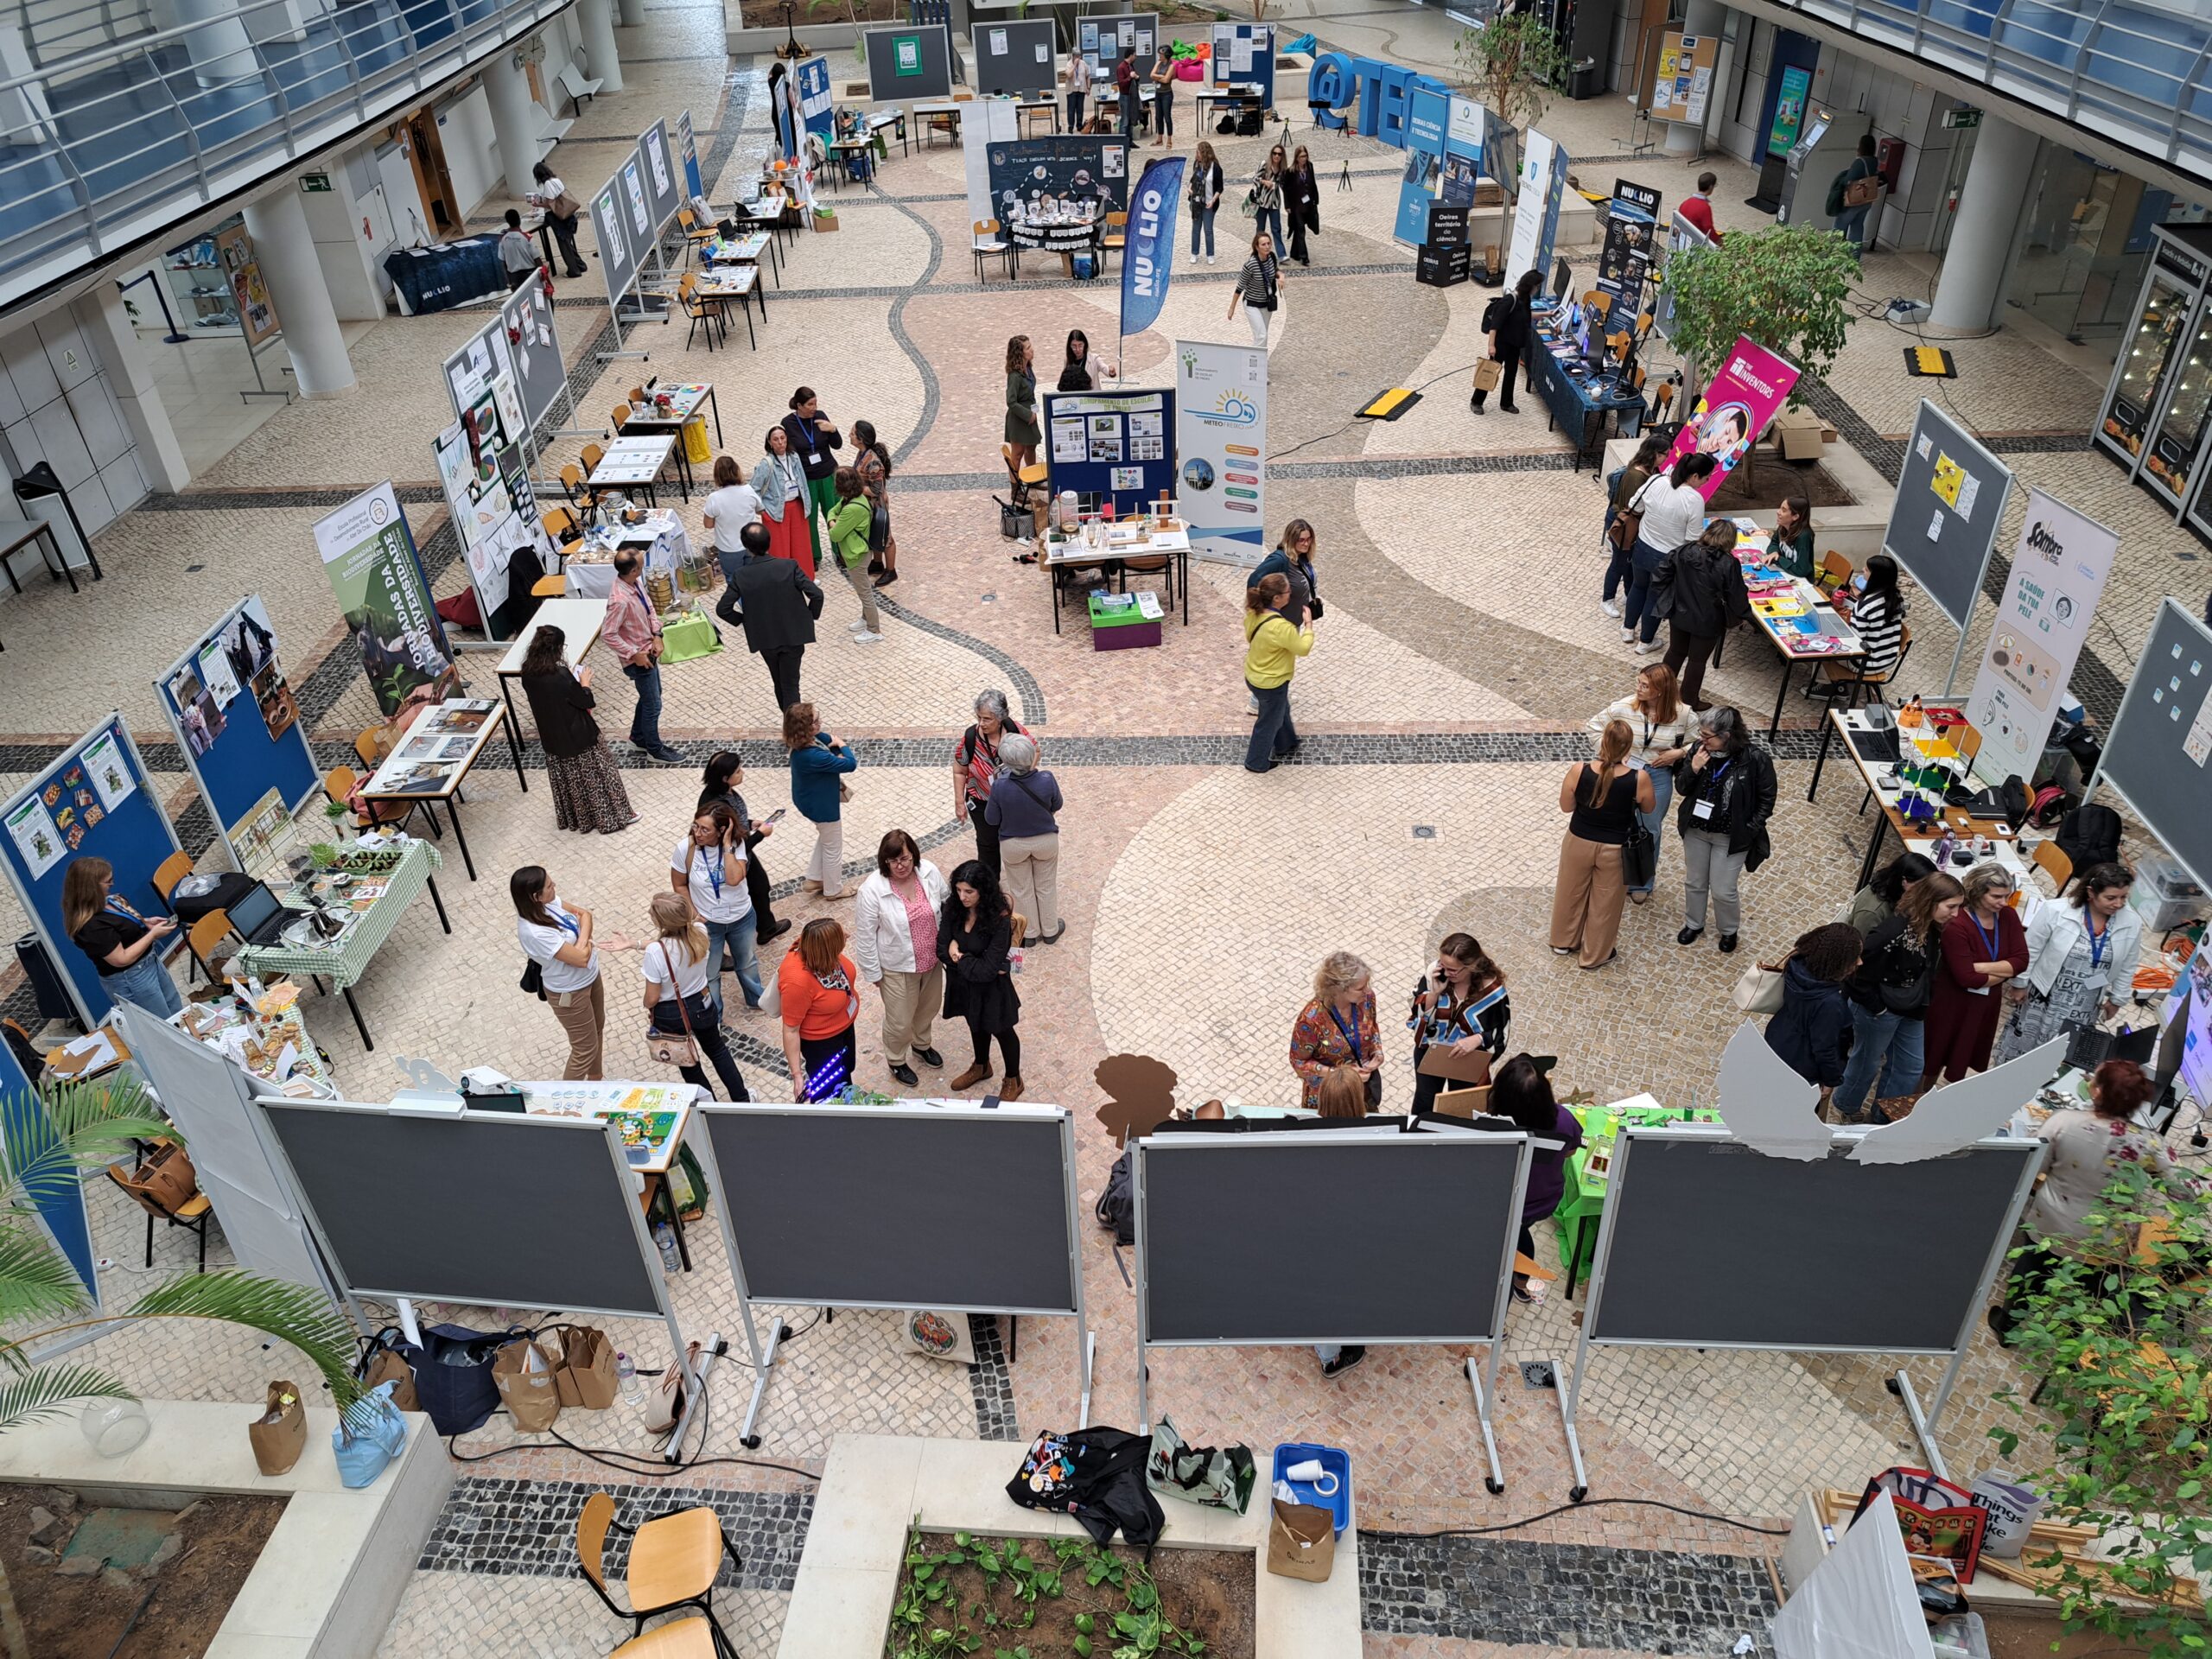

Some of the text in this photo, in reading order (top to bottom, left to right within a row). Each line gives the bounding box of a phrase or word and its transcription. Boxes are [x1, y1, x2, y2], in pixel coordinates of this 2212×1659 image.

[1620, 185, 1655, 206] NUCLIO
[1134, 189, 1162, 297] NUCLIO
[423, 285, 451, 301] NUCLIO
[1738, 368, 1776, 399] INVENTORS
[2026, 521, 2063, 556] Sombra
[384, 532, 437, 662] BIODIVERSIDADE
[2018, 577, 2046, 601] A SAÚDE
[2018, 590, 2026, 601] DA
[381, 563, 426, 671] JORNADAS DA
[2018, 604, 2033, 620] PELE
[1974, 1492, 2024, 1524] Things
